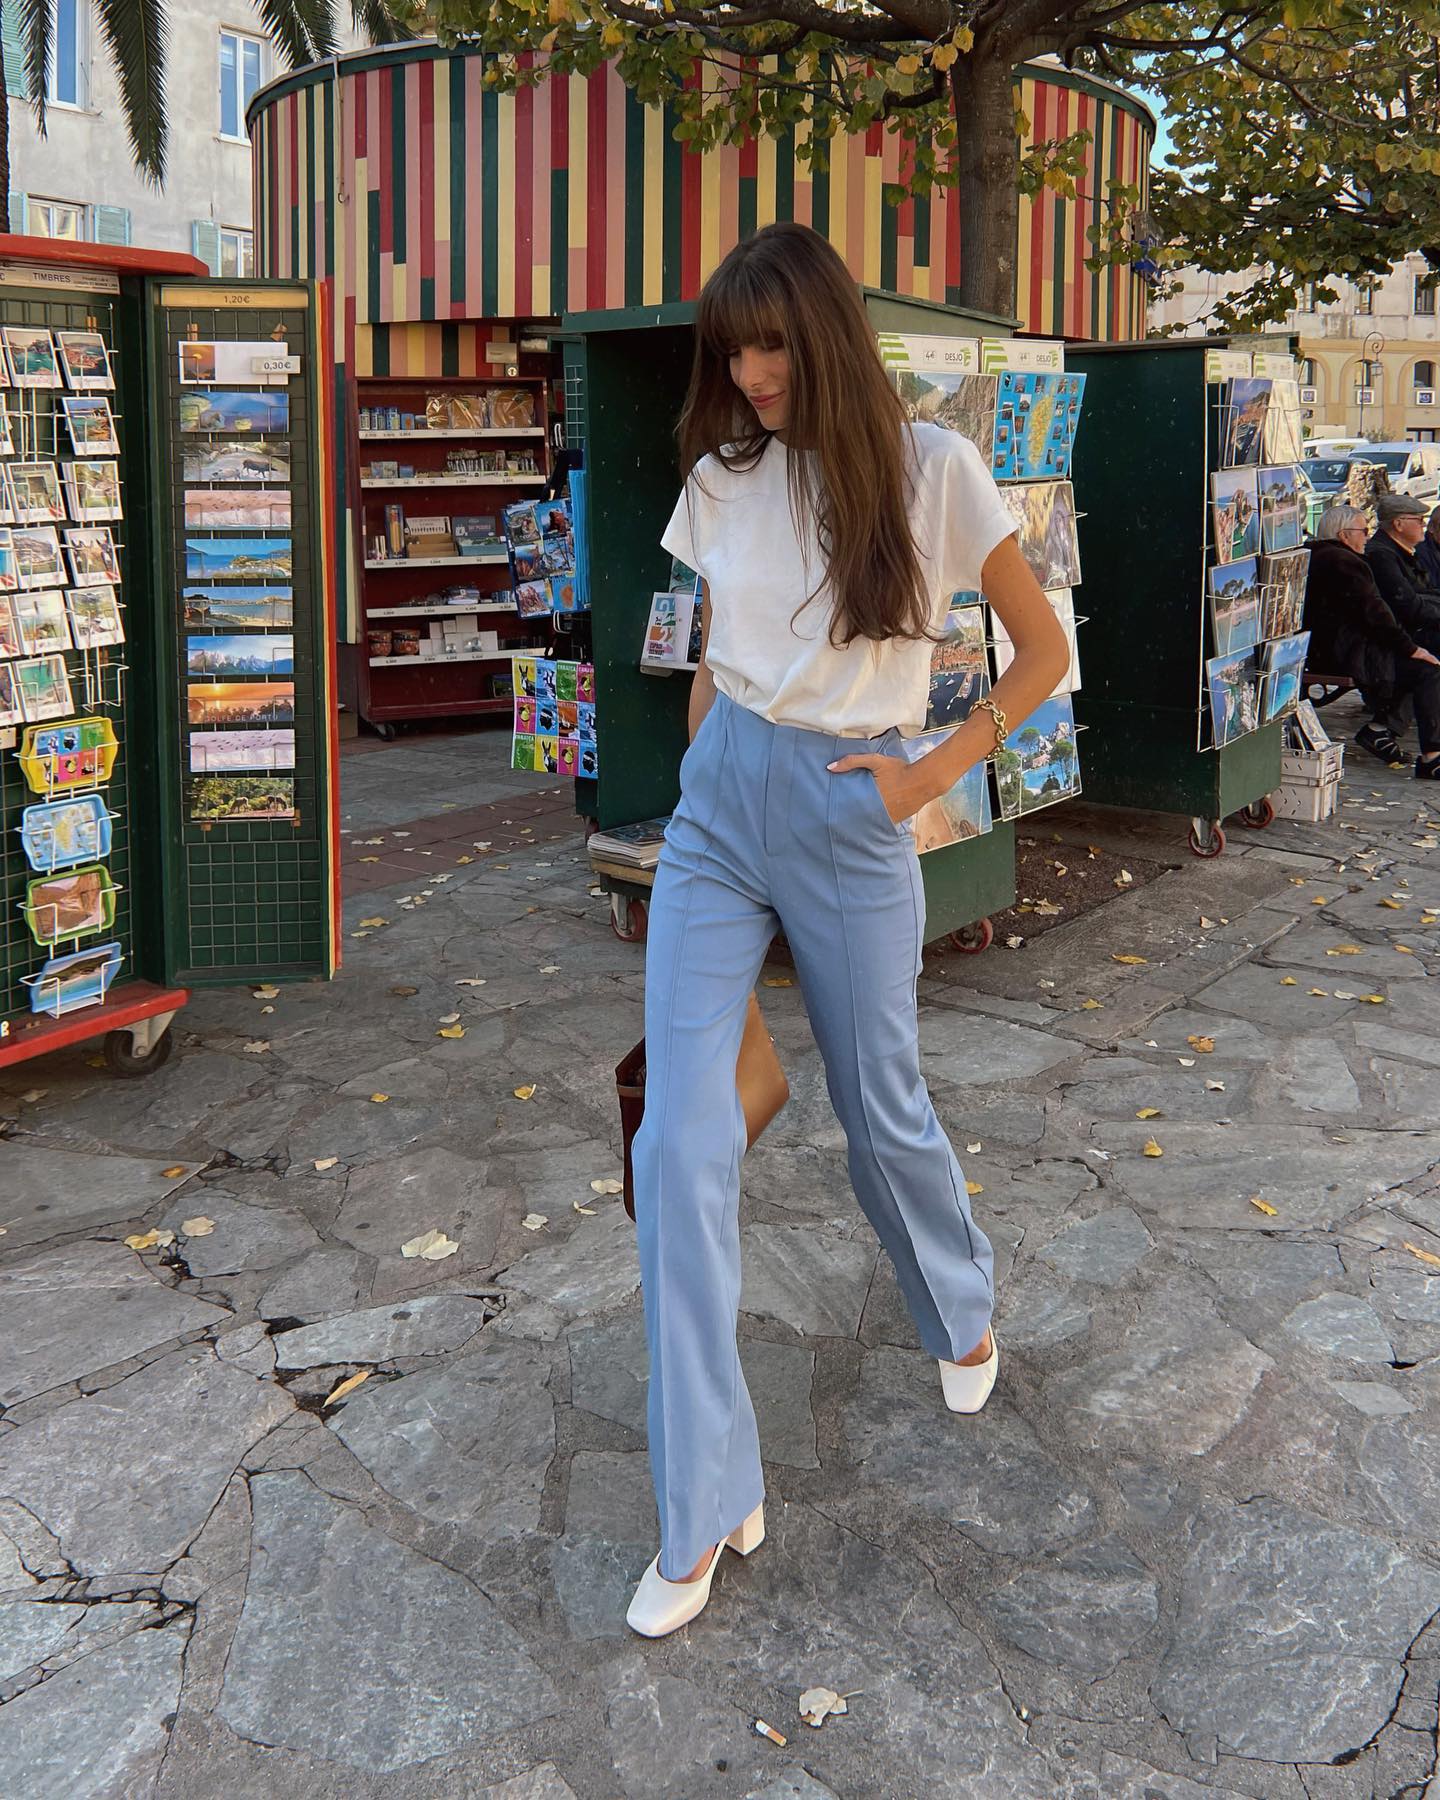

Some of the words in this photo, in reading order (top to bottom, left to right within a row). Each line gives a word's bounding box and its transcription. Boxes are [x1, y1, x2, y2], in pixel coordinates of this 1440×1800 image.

[33, 272, 71, 283] TIMBRES
[223, 295, 251, 304] 1,20€
[263, 361, 291, 371] 0,30€
